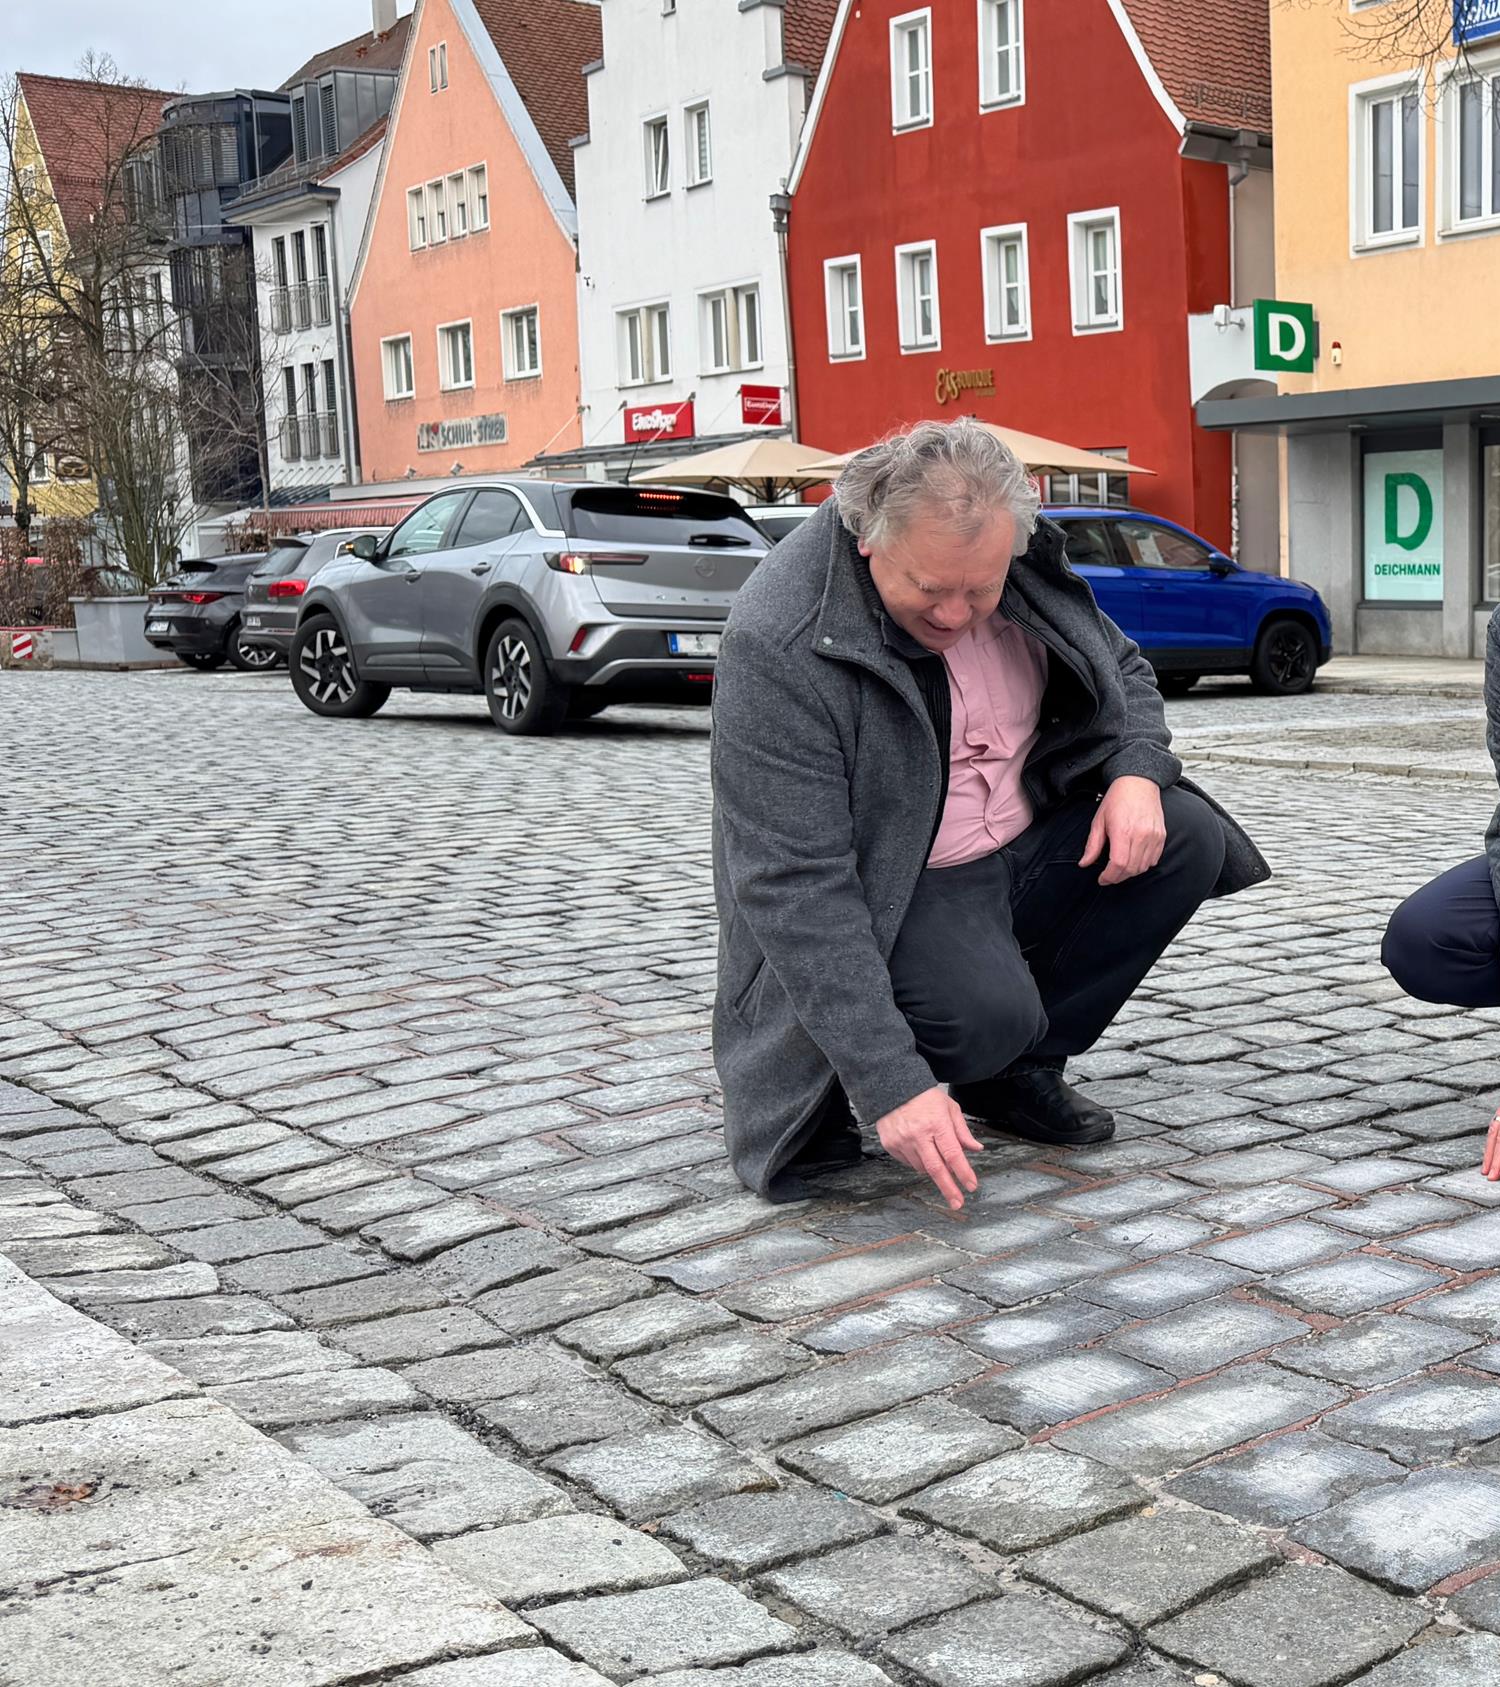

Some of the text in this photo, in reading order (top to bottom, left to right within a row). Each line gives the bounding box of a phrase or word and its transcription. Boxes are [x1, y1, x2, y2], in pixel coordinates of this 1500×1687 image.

[1268, 312, 1306, 361] D
[1384, 472, 1433, 551] D
[1374, 563, 1441, 577] DEICHMANN
